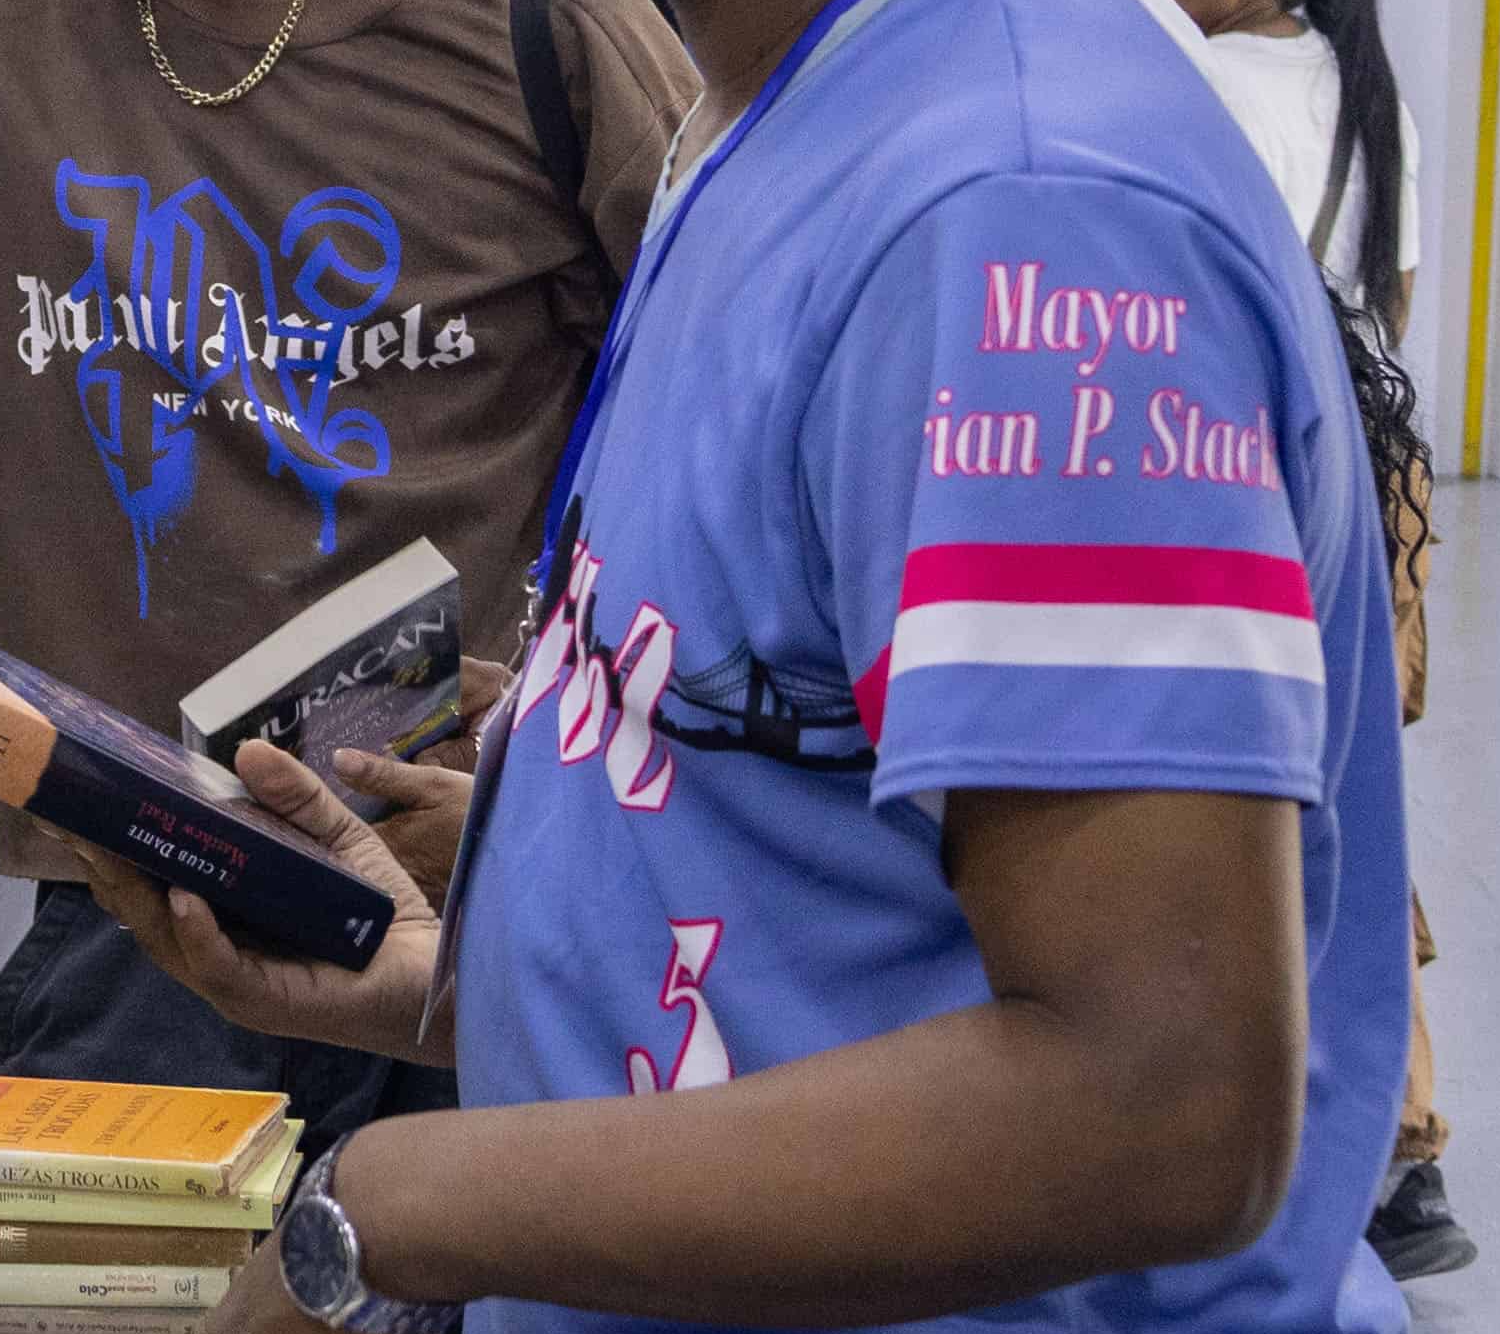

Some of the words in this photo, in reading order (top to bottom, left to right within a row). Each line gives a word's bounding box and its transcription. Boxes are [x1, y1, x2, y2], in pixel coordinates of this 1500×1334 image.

[979, 263, 1188, 376] Mayor
[221, 398, 303, 433] YORK
[1062, 386, 1116, 478] P.
[29, 1190, 57, 1204] Entre
[56, 1168, 161, 1192] TROCADAS
